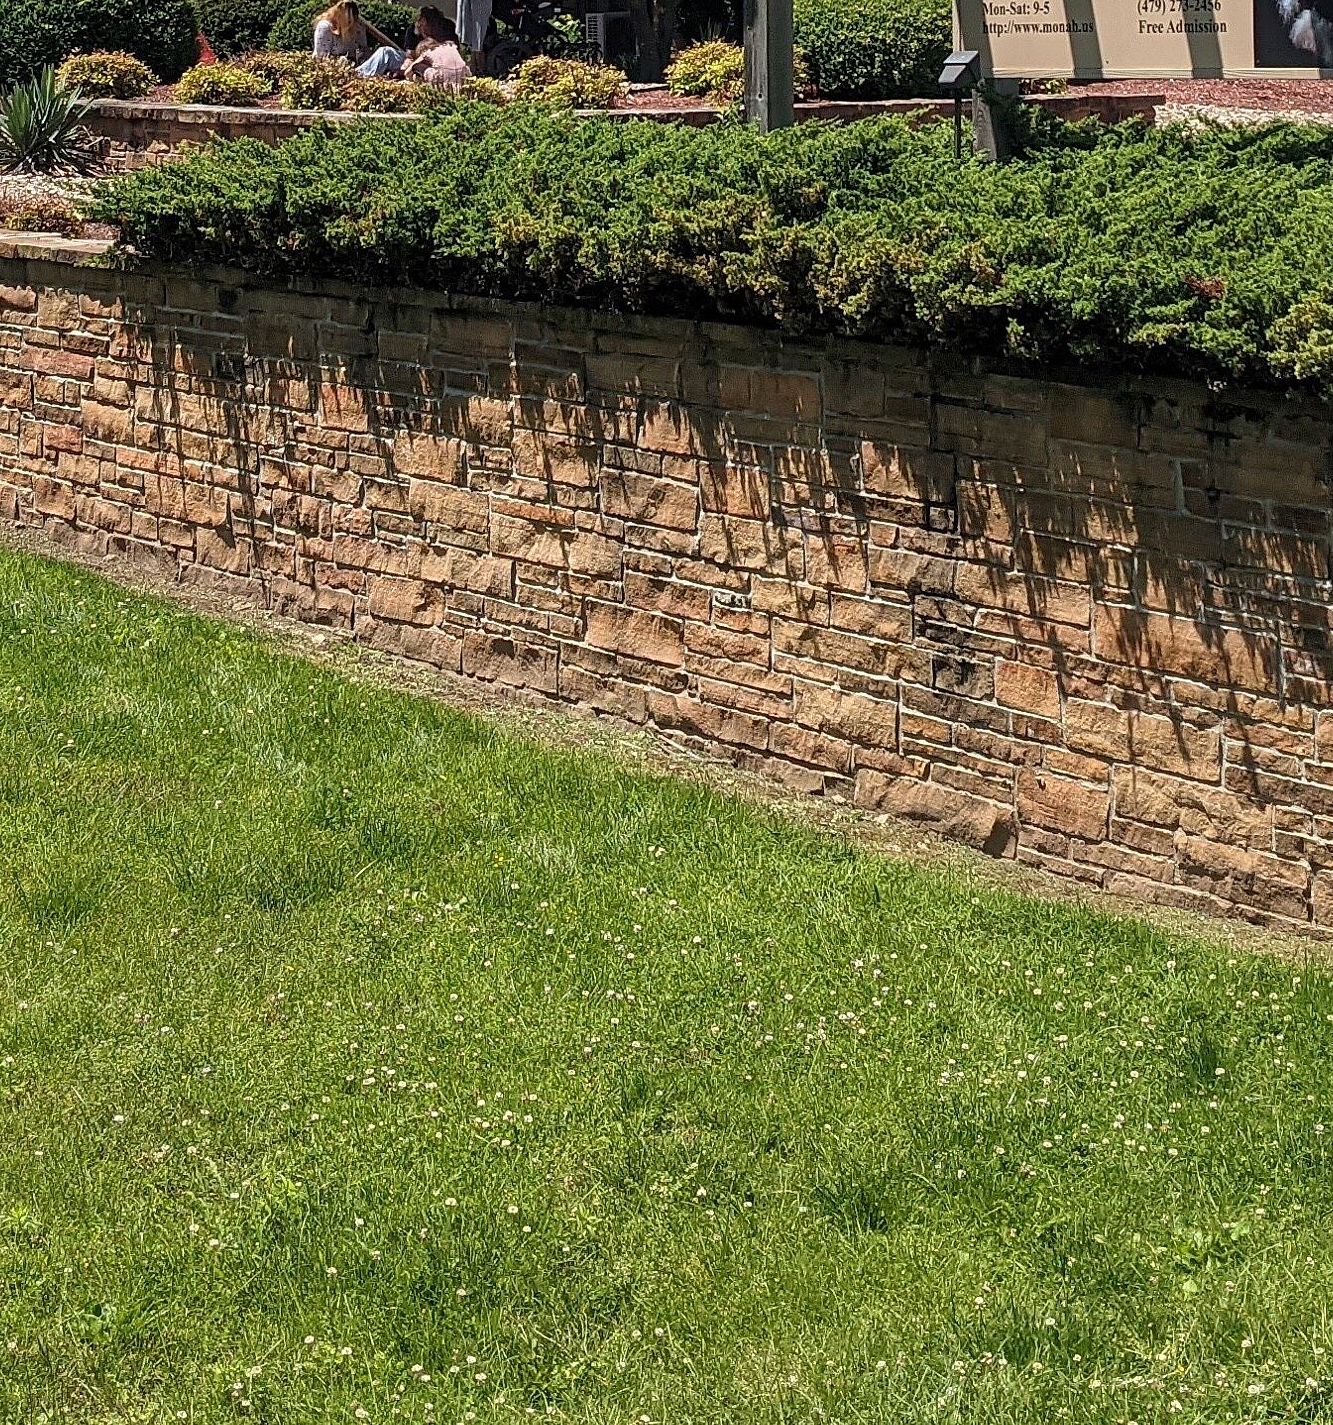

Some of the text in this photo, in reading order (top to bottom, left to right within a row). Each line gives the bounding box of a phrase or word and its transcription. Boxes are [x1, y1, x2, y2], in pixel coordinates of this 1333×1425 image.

[982, 1, 1050, 15] Mon-Sat: 9-5
[982, 19, 1094, 37] http://www.monah.us
[1138, 19, 1228, 34] Free Admission
